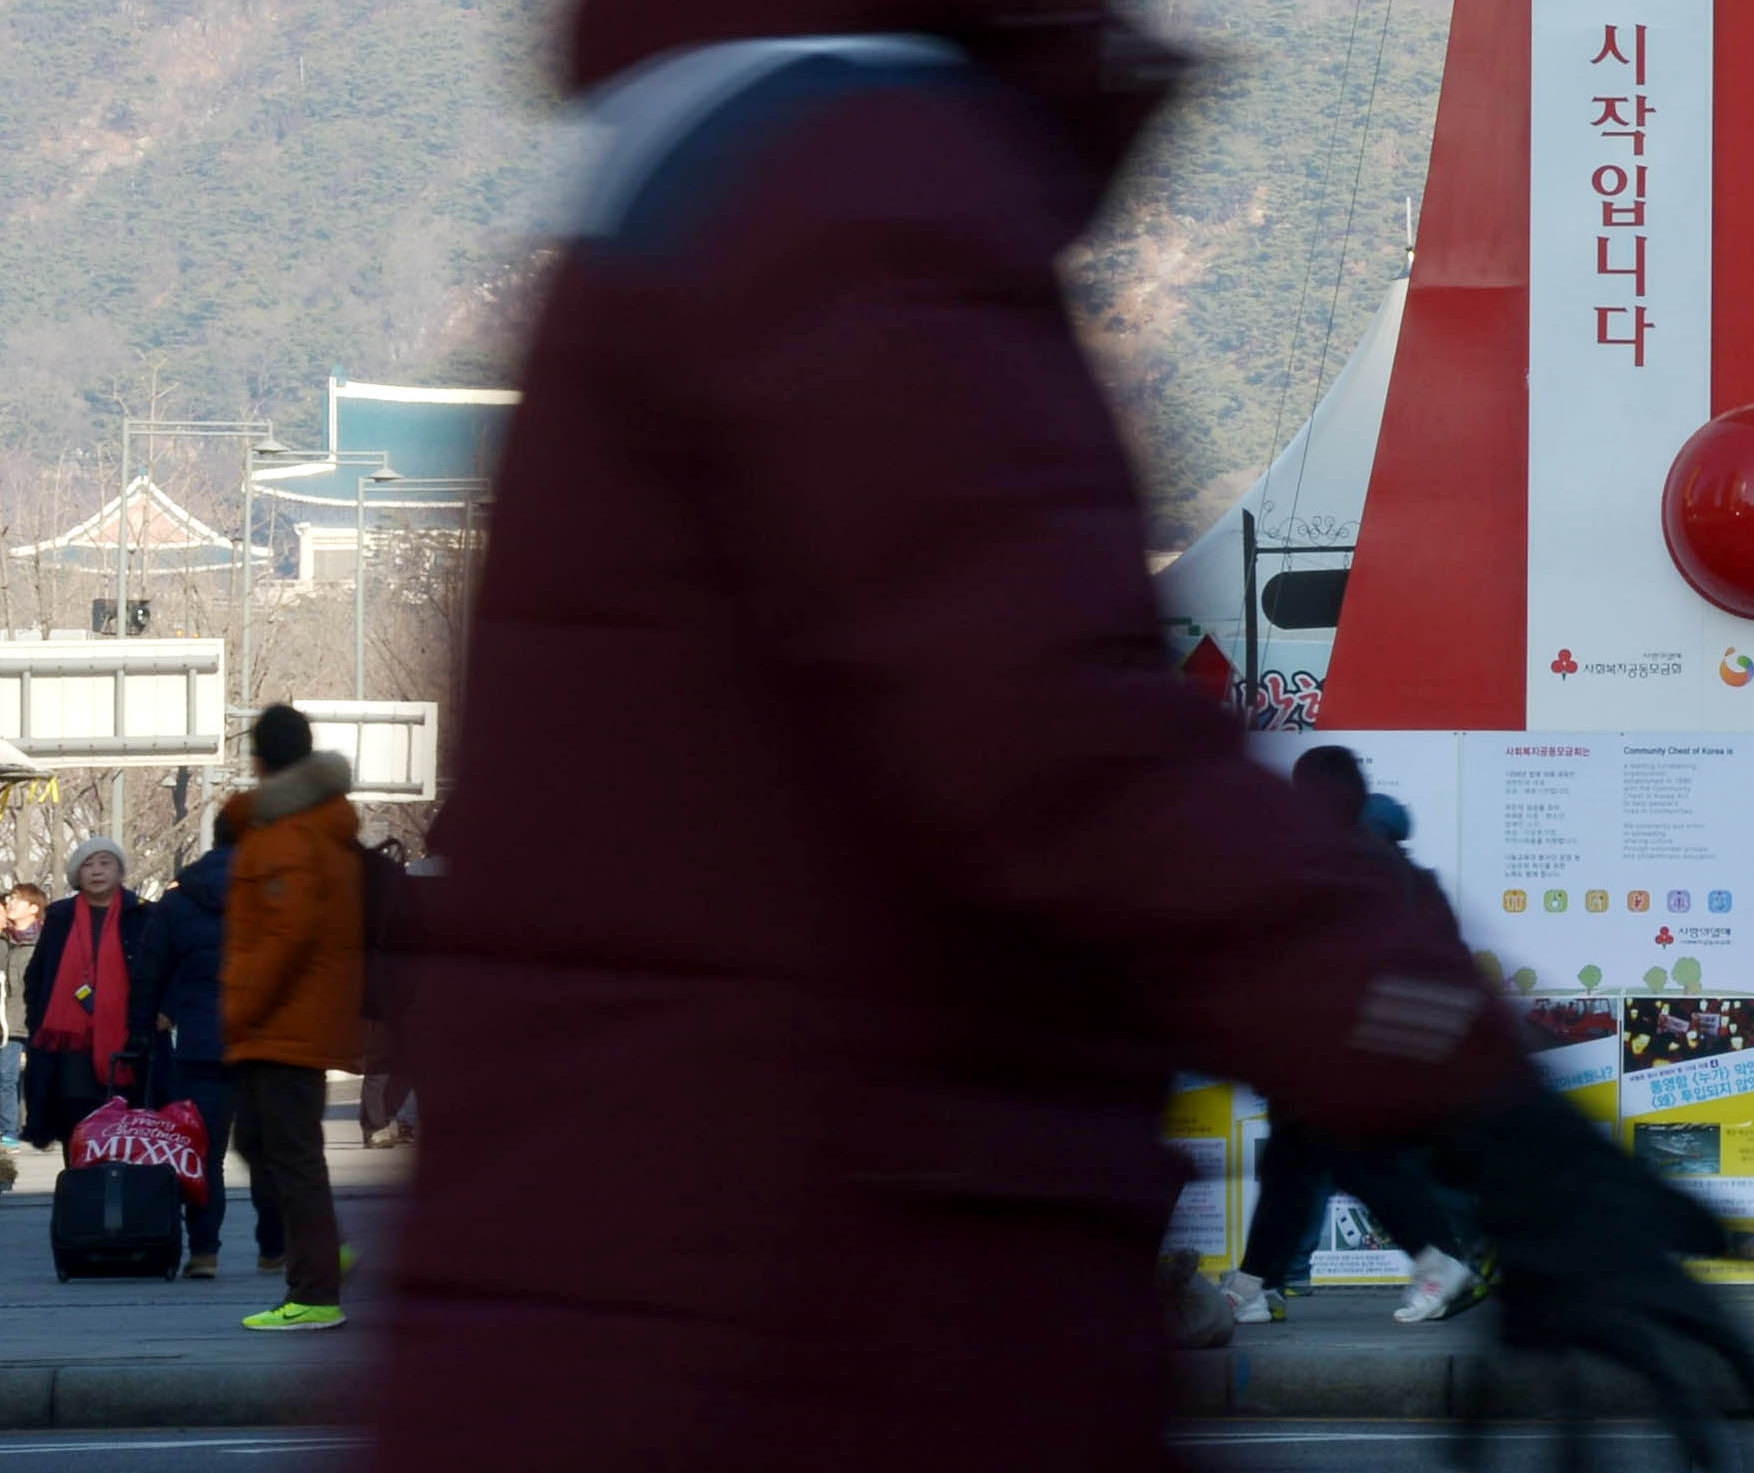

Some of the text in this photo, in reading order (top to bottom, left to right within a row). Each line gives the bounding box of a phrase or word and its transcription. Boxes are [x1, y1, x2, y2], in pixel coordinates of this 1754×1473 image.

[1590, 24, 1657, 368] 시작입니다
[1623, 746, 1665, 757] Community
[1668, 746, 1691, 756] Chest
[1702, 746, 1724, 756] Korea
[84, 1135, 203, 1178] MIXXO
